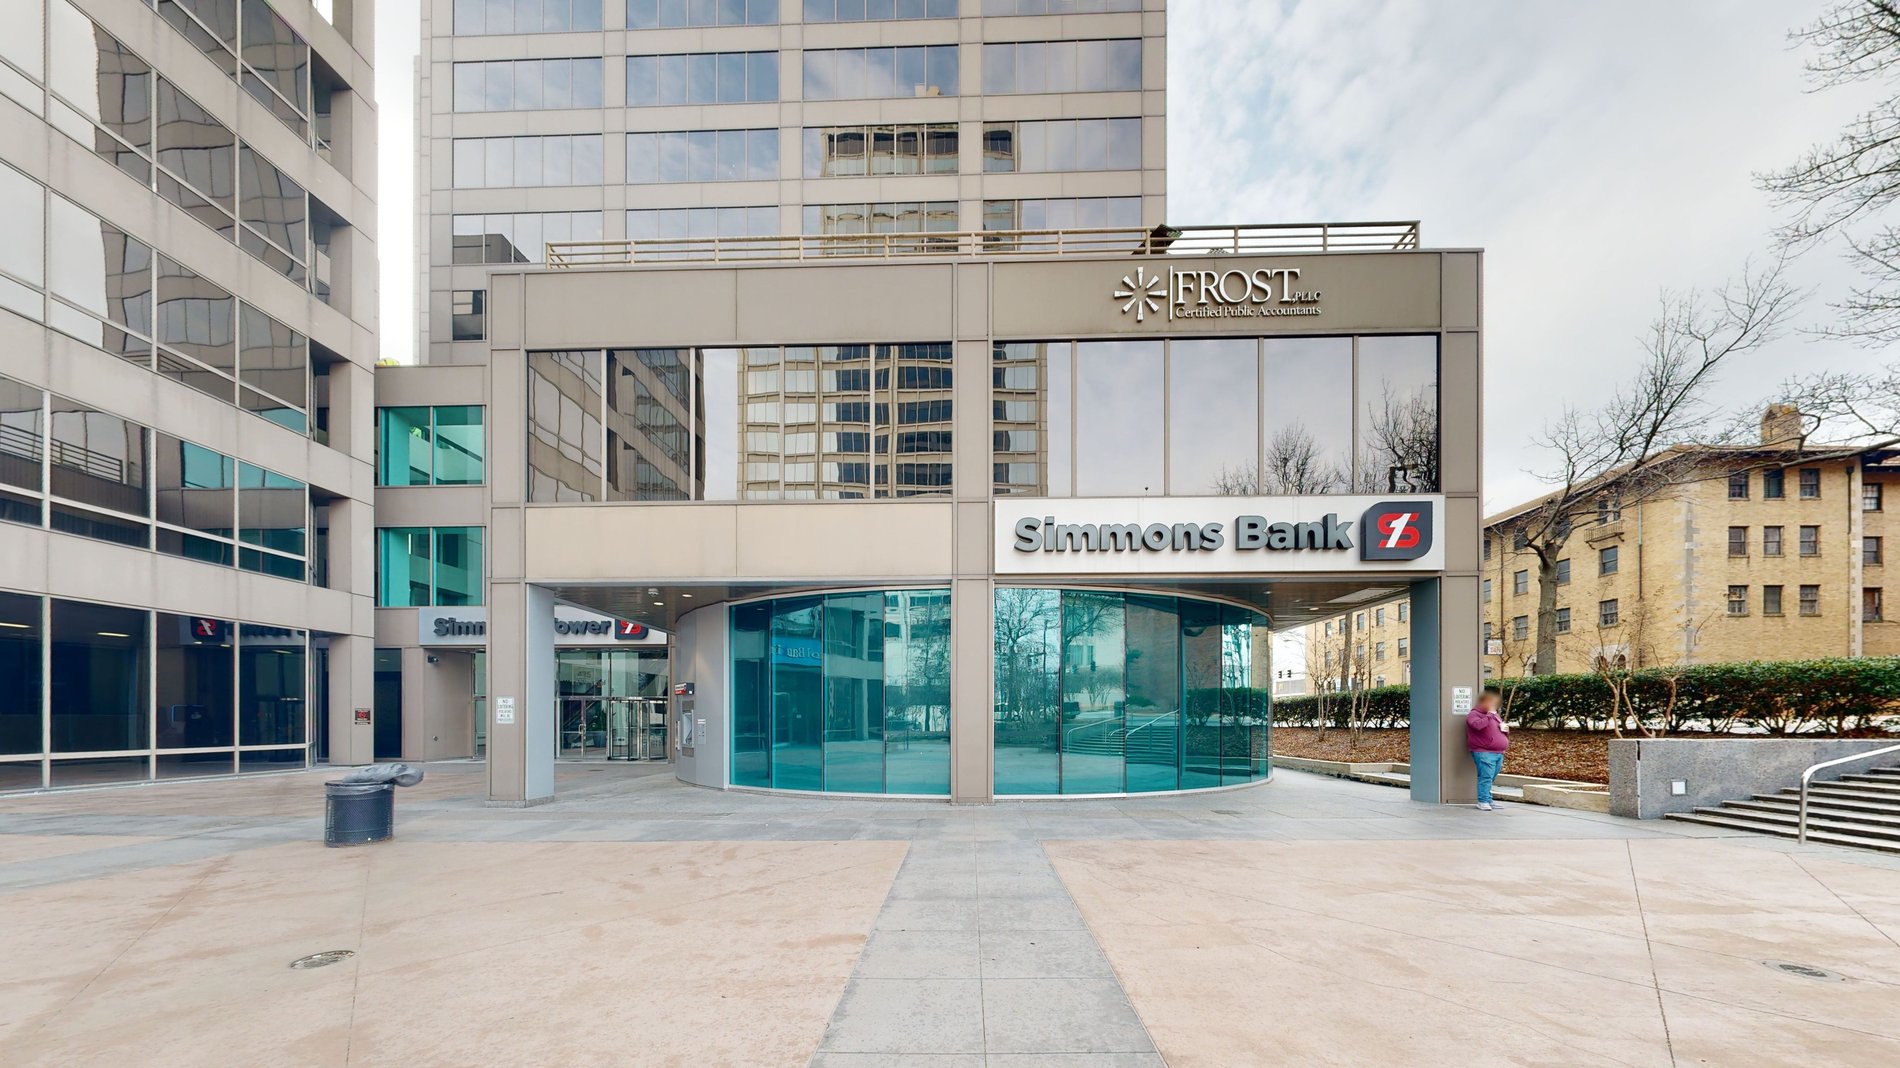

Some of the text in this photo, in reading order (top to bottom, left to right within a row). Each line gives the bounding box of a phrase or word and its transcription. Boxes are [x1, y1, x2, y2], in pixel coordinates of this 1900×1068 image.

[1175, 305, 1322, 318] Certified Public Accountants
[1013, 513, 1354, 553] Simmons Bank
[433, 617, 611, 636] Simm ower
